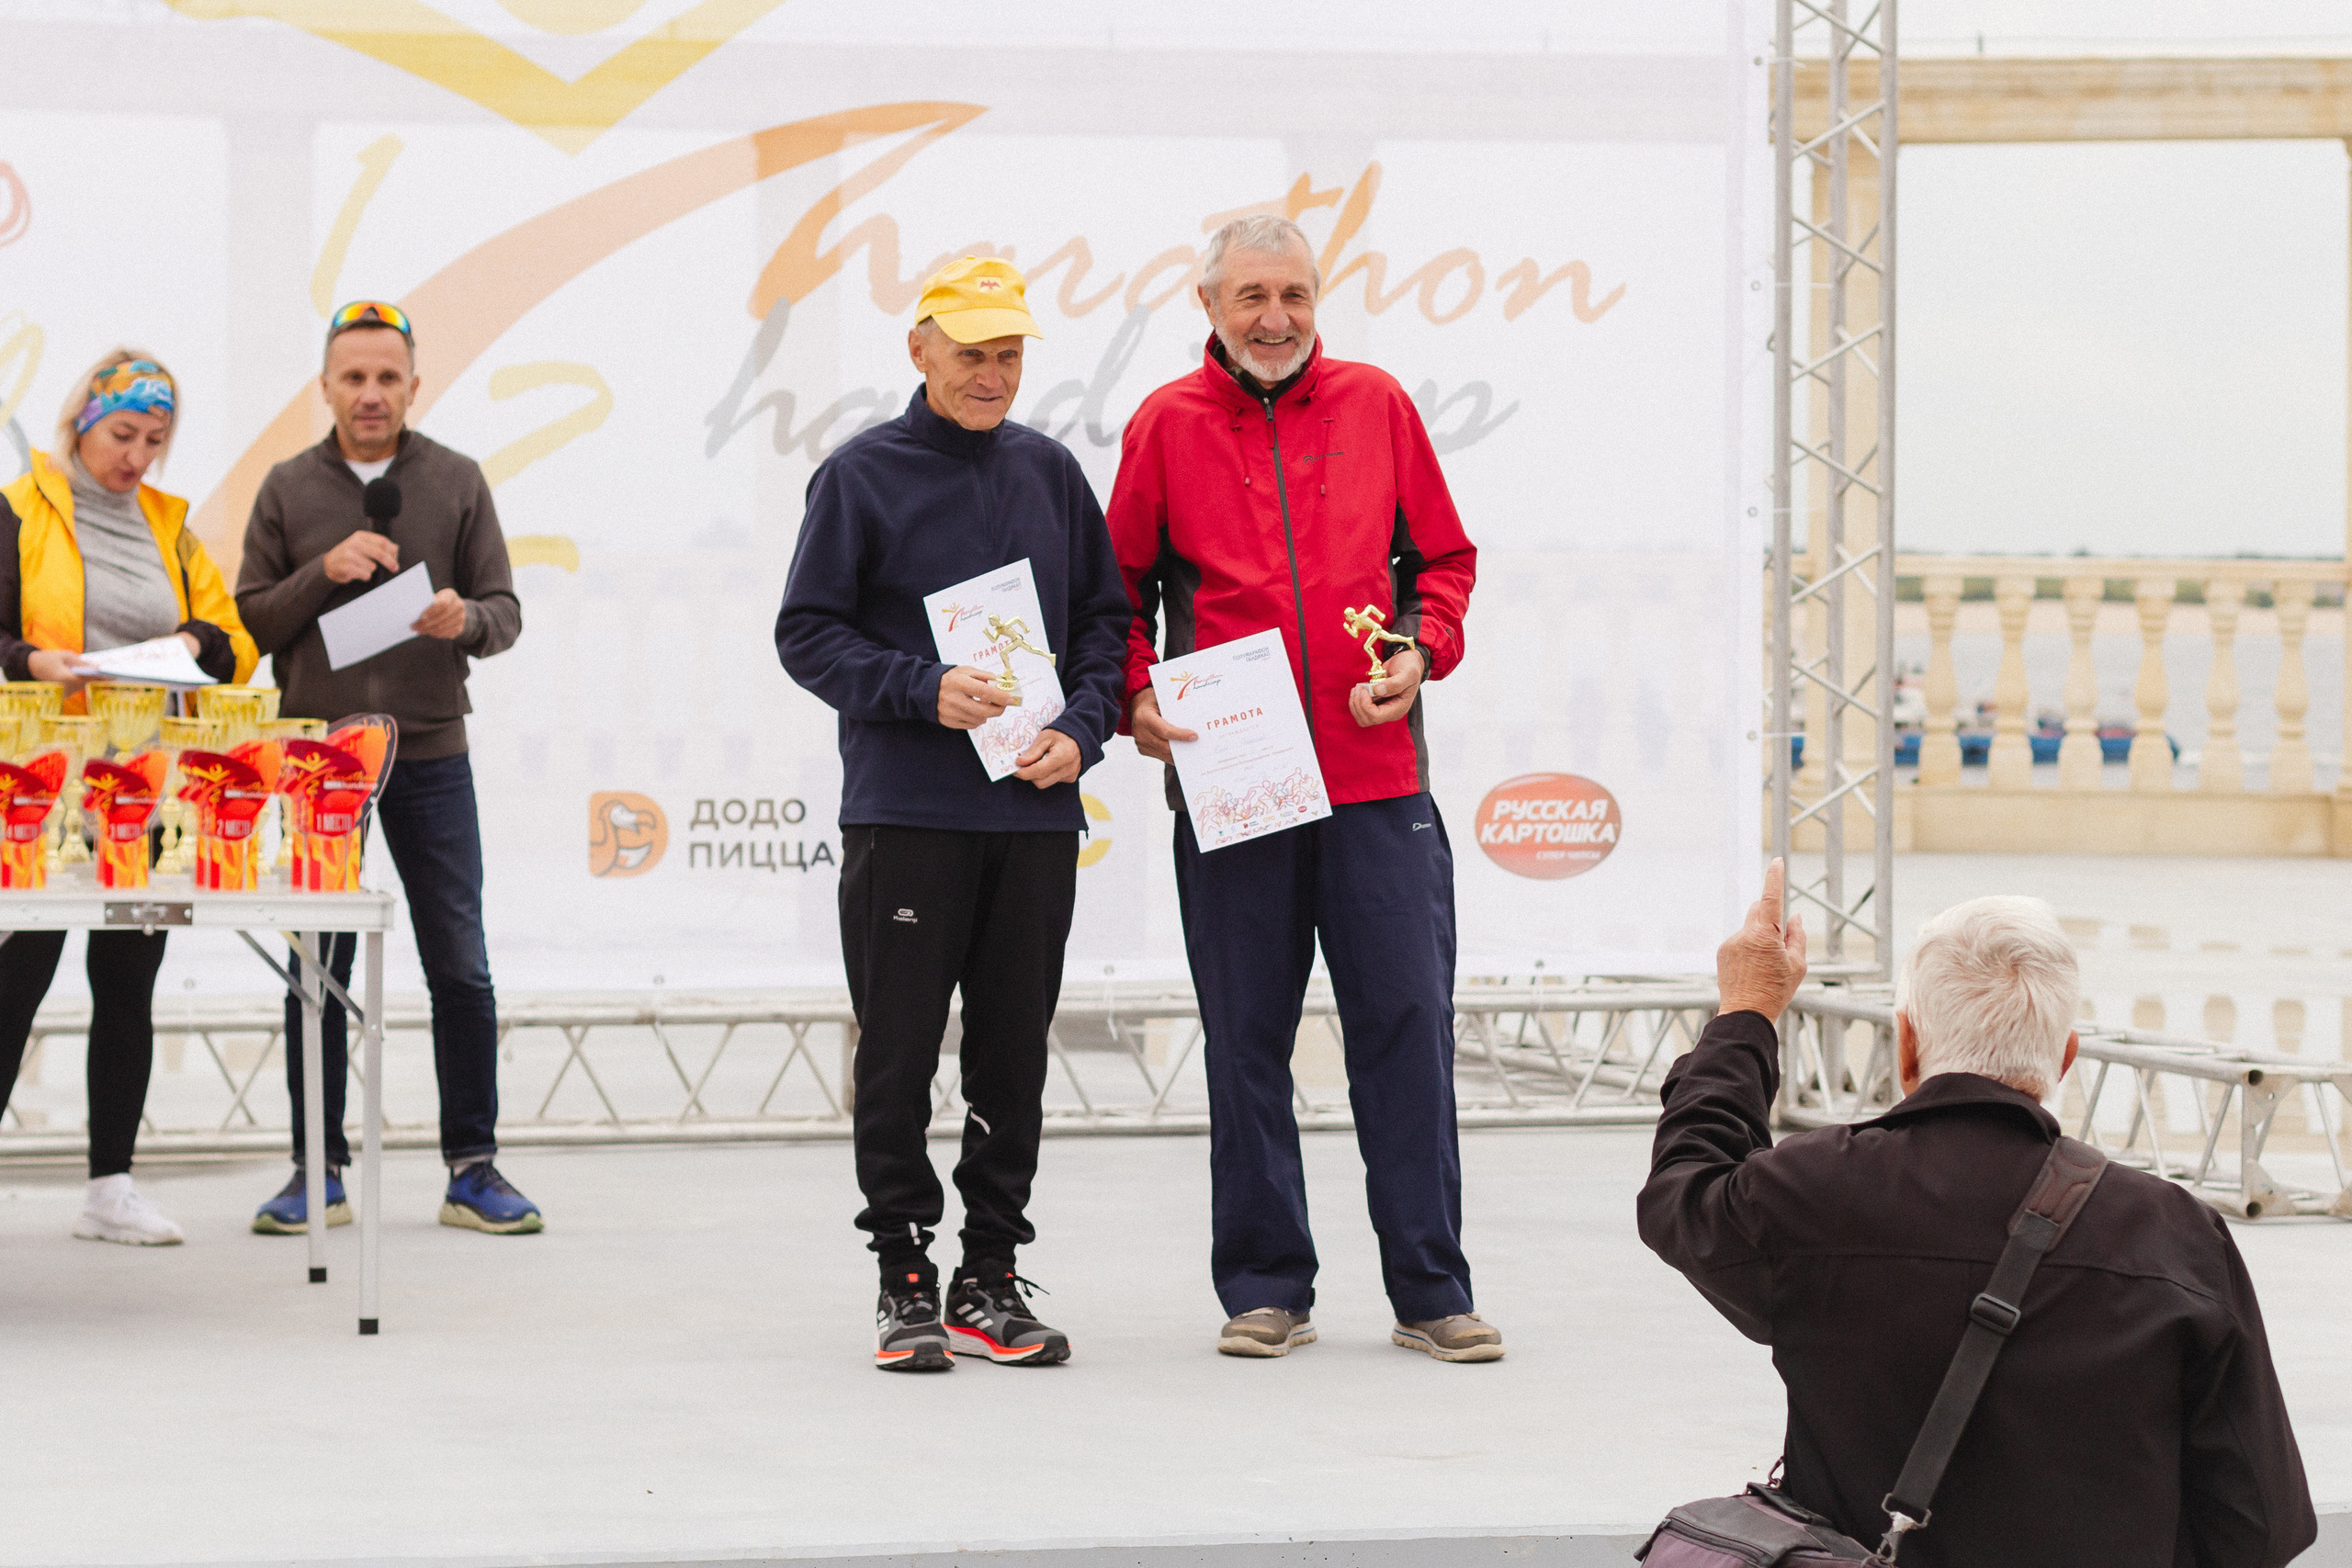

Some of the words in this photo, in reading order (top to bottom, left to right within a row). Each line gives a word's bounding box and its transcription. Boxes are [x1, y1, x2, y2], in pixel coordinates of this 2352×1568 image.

[972, 639, 1010, 662] ГРАМОТ
[1206, 706, 1263, 730] ГРАМОТА
[690, 798, 806, 830] ДОДО
[1491, 799, 1608, 821] РУССКАЯ
[1479, 823, 1617, 844] КАРТОШКА
[689, 840, 835, 873] ПИЦЦА
